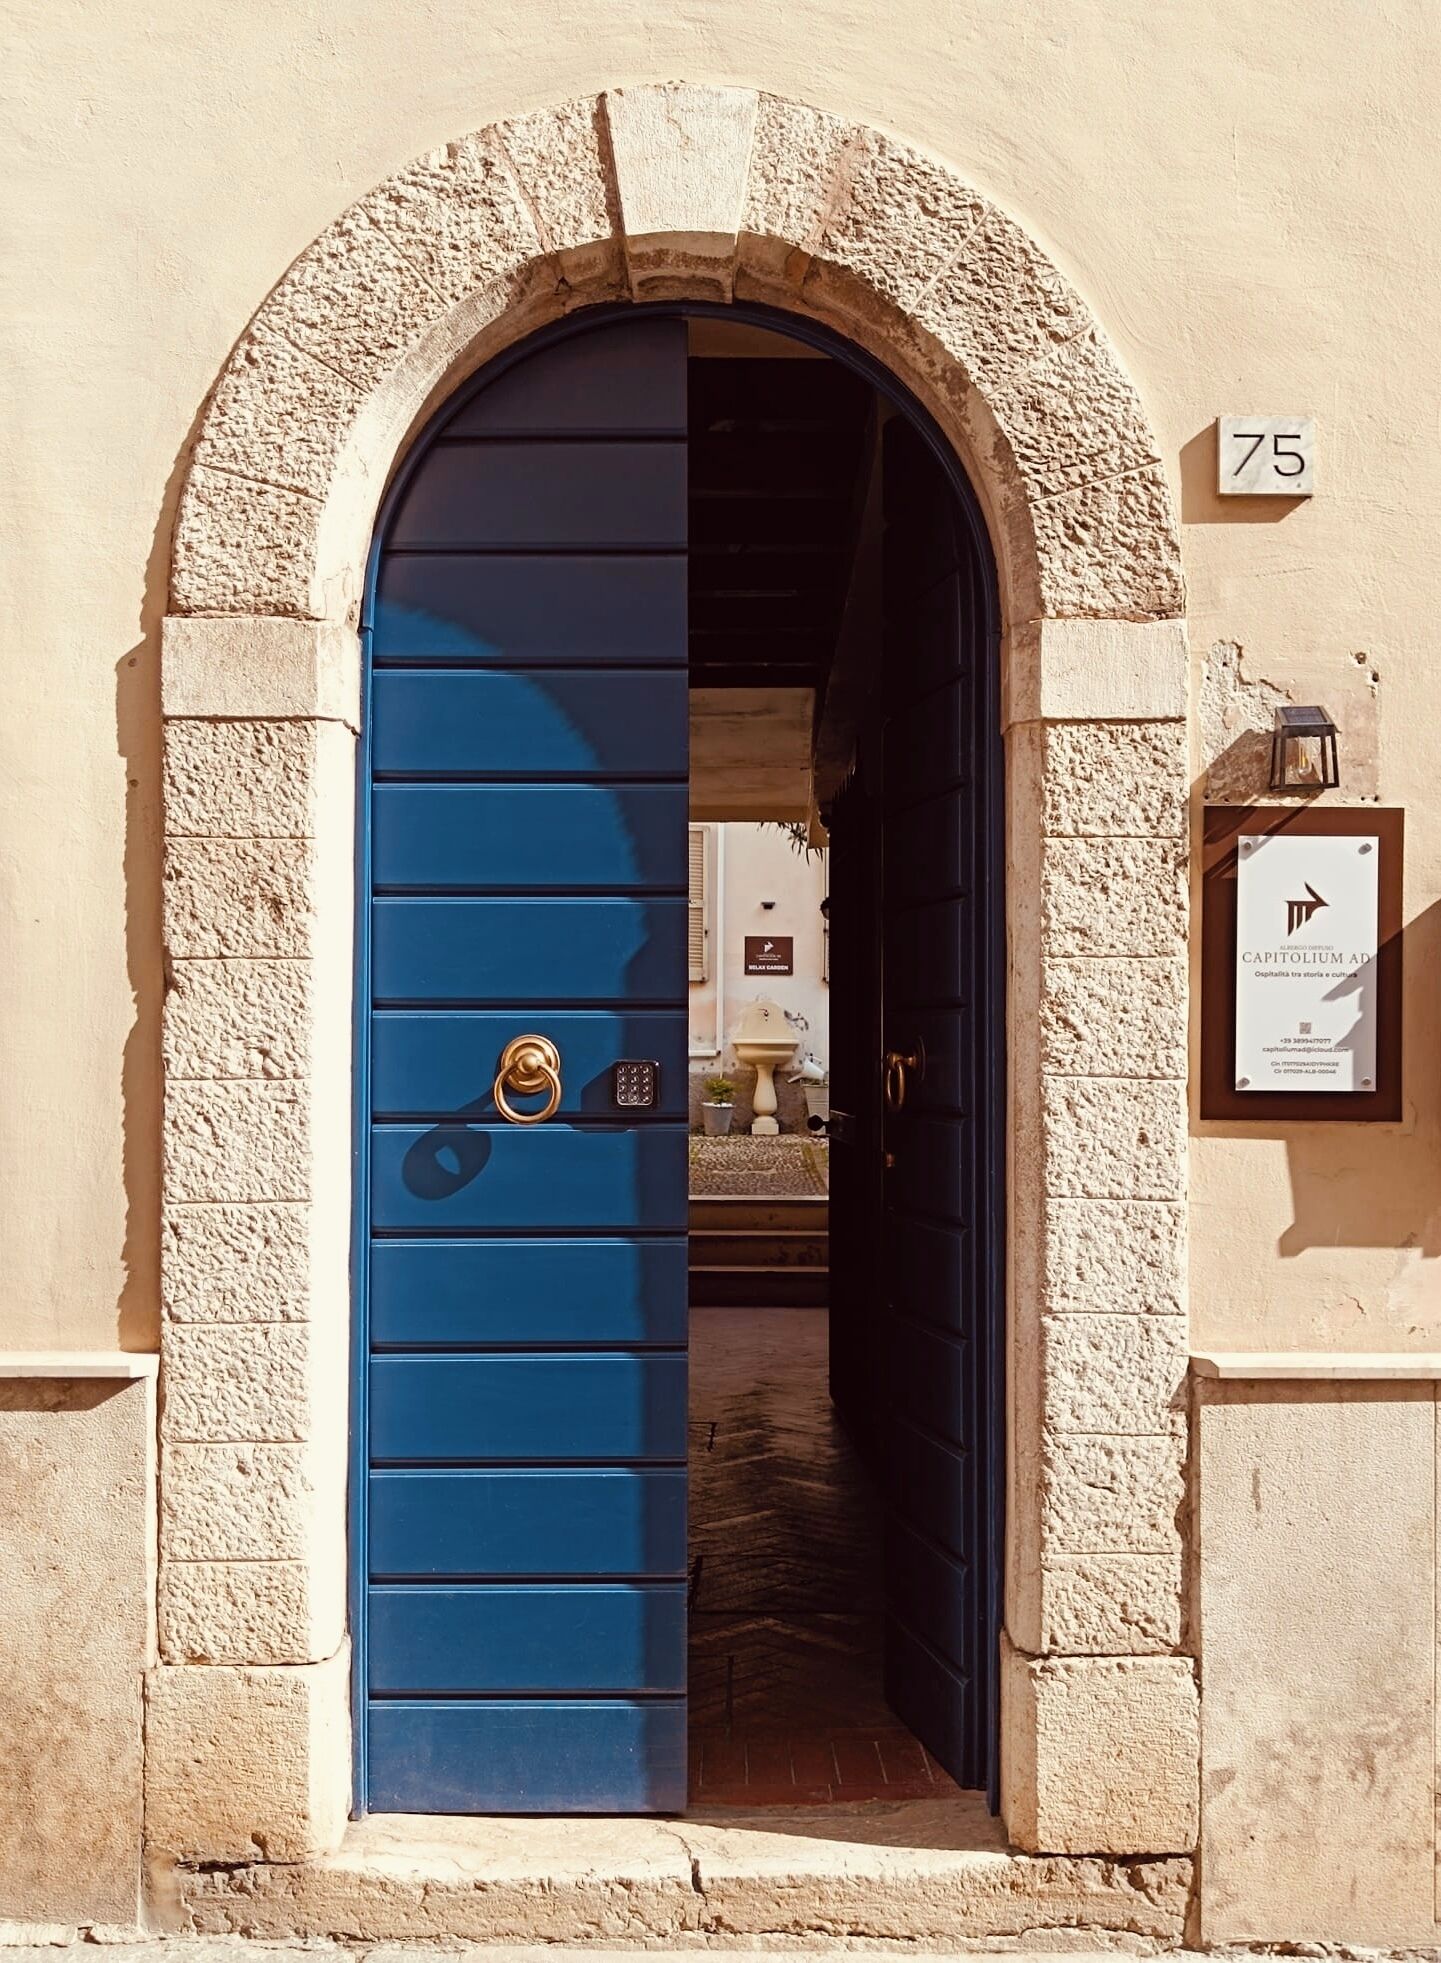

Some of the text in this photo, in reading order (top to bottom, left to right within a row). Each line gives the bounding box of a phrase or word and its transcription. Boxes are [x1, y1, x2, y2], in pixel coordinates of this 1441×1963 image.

[1233, 434, 1305, 476] 75
[1242, 952, 1371, 964] CAPITOLIUM AD
[1254, 970, 1290, 979] Ospitalità
